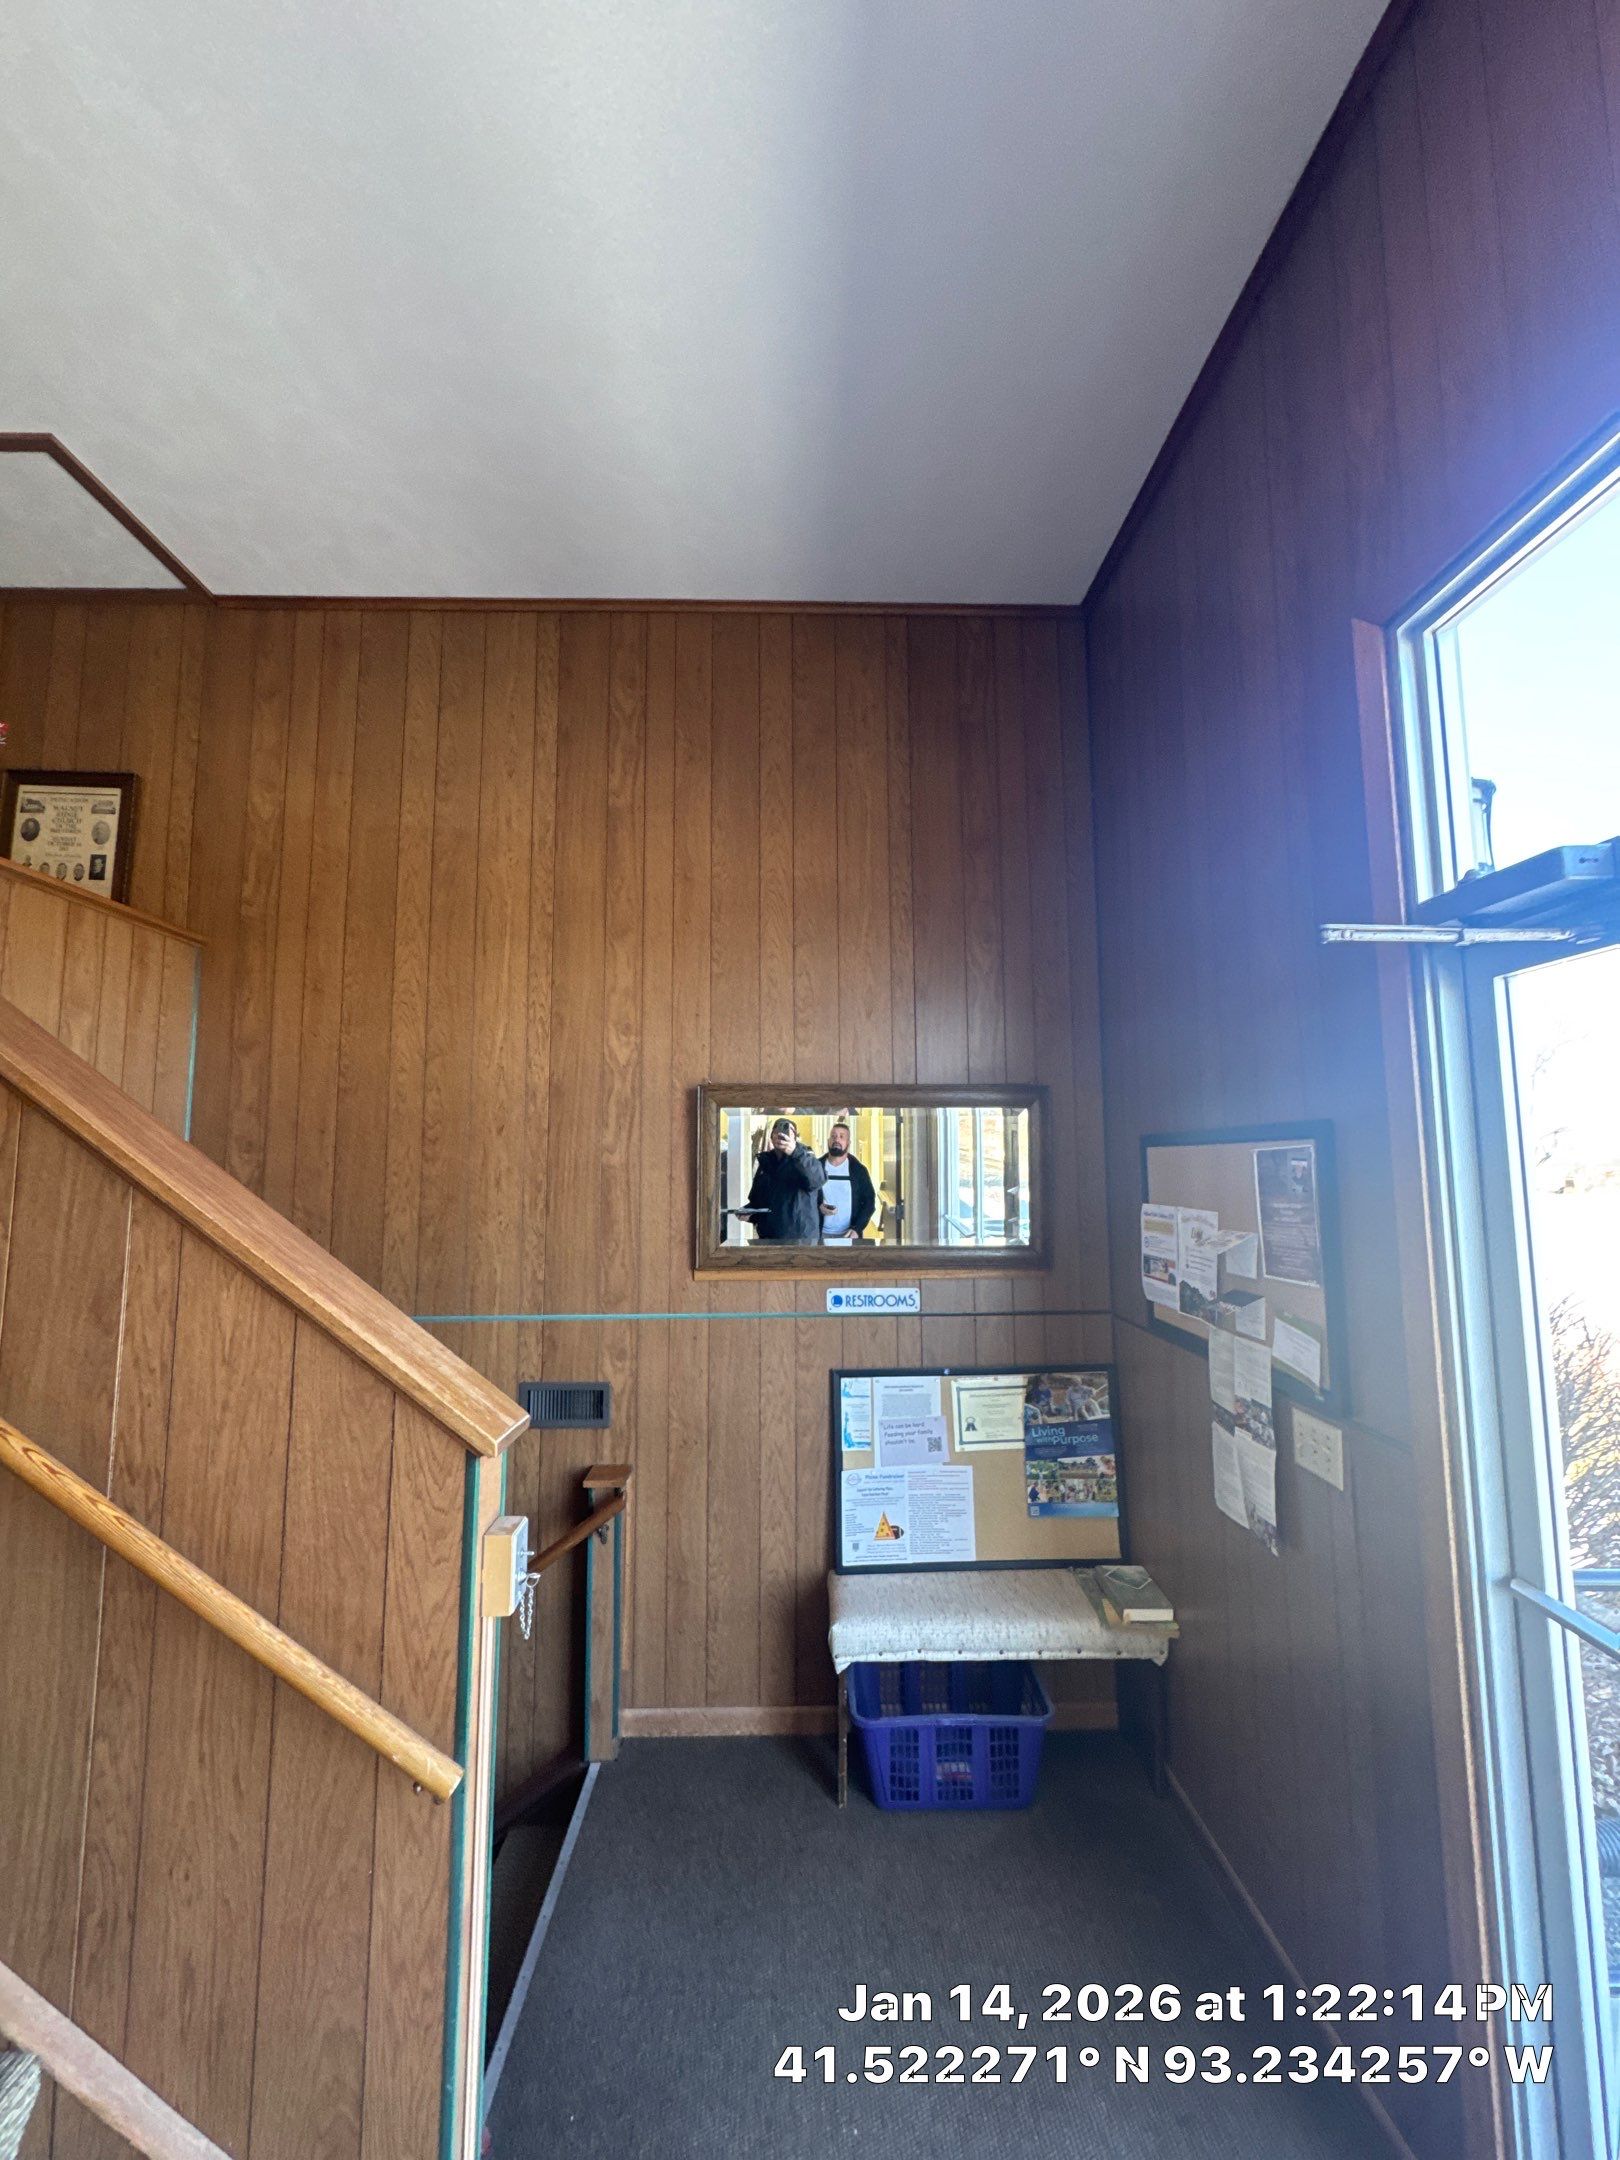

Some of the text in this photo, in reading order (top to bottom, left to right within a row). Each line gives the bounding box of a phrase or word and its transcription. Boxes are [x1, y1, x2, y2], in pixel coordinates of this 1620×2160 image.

[845, 1294, 916, 1307] RESTROOMS
[1031, 1426, 1065, 1437] Living
[1053, 1433, 1099, 1445] Purpose
